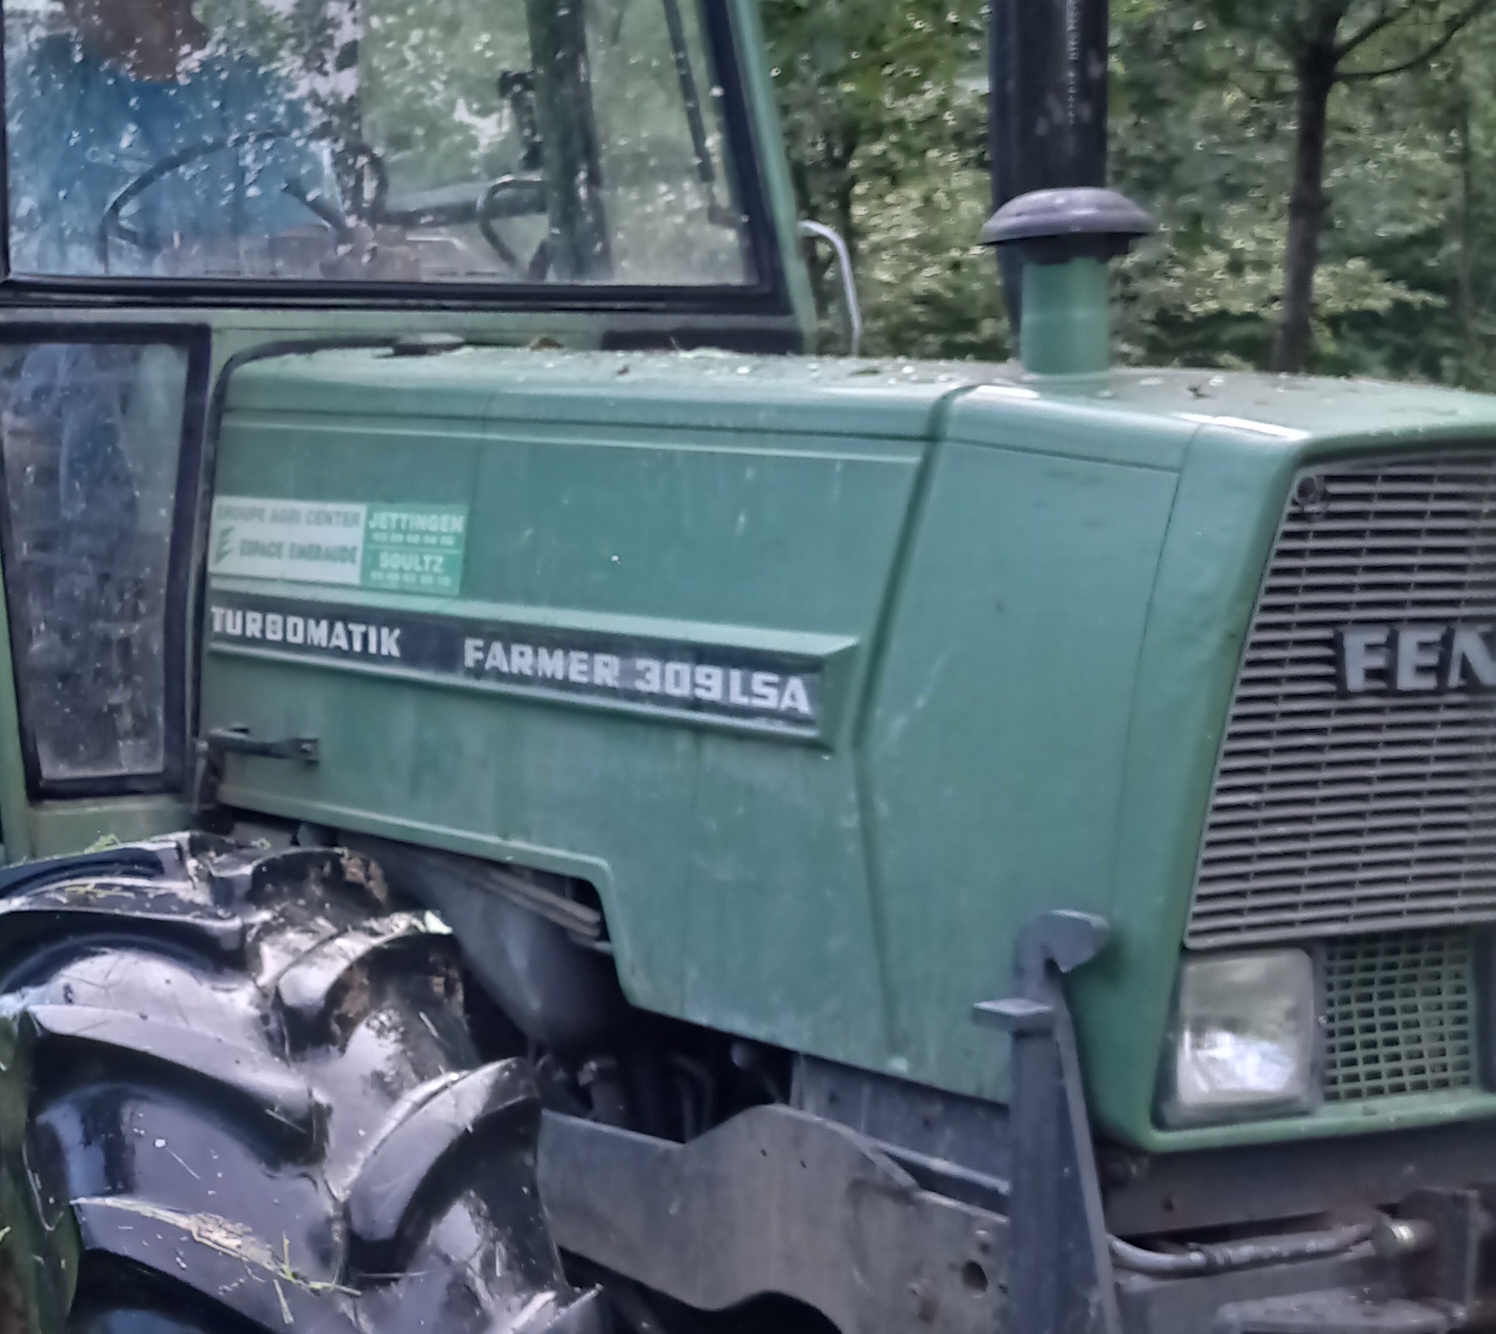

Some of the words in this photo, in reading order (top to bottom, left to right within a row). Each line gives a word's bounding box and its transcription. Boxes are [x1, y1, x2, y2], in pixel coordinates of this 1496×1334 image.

[306, 510, 361, 528] CENTER
[368, 512, 465, 533] JETTINGEN
[379, 552, 445, 573] SOULTZ
[211, 606, 400, 657] TURBOMATIK
[463, 636, 619, 688] FARMER
